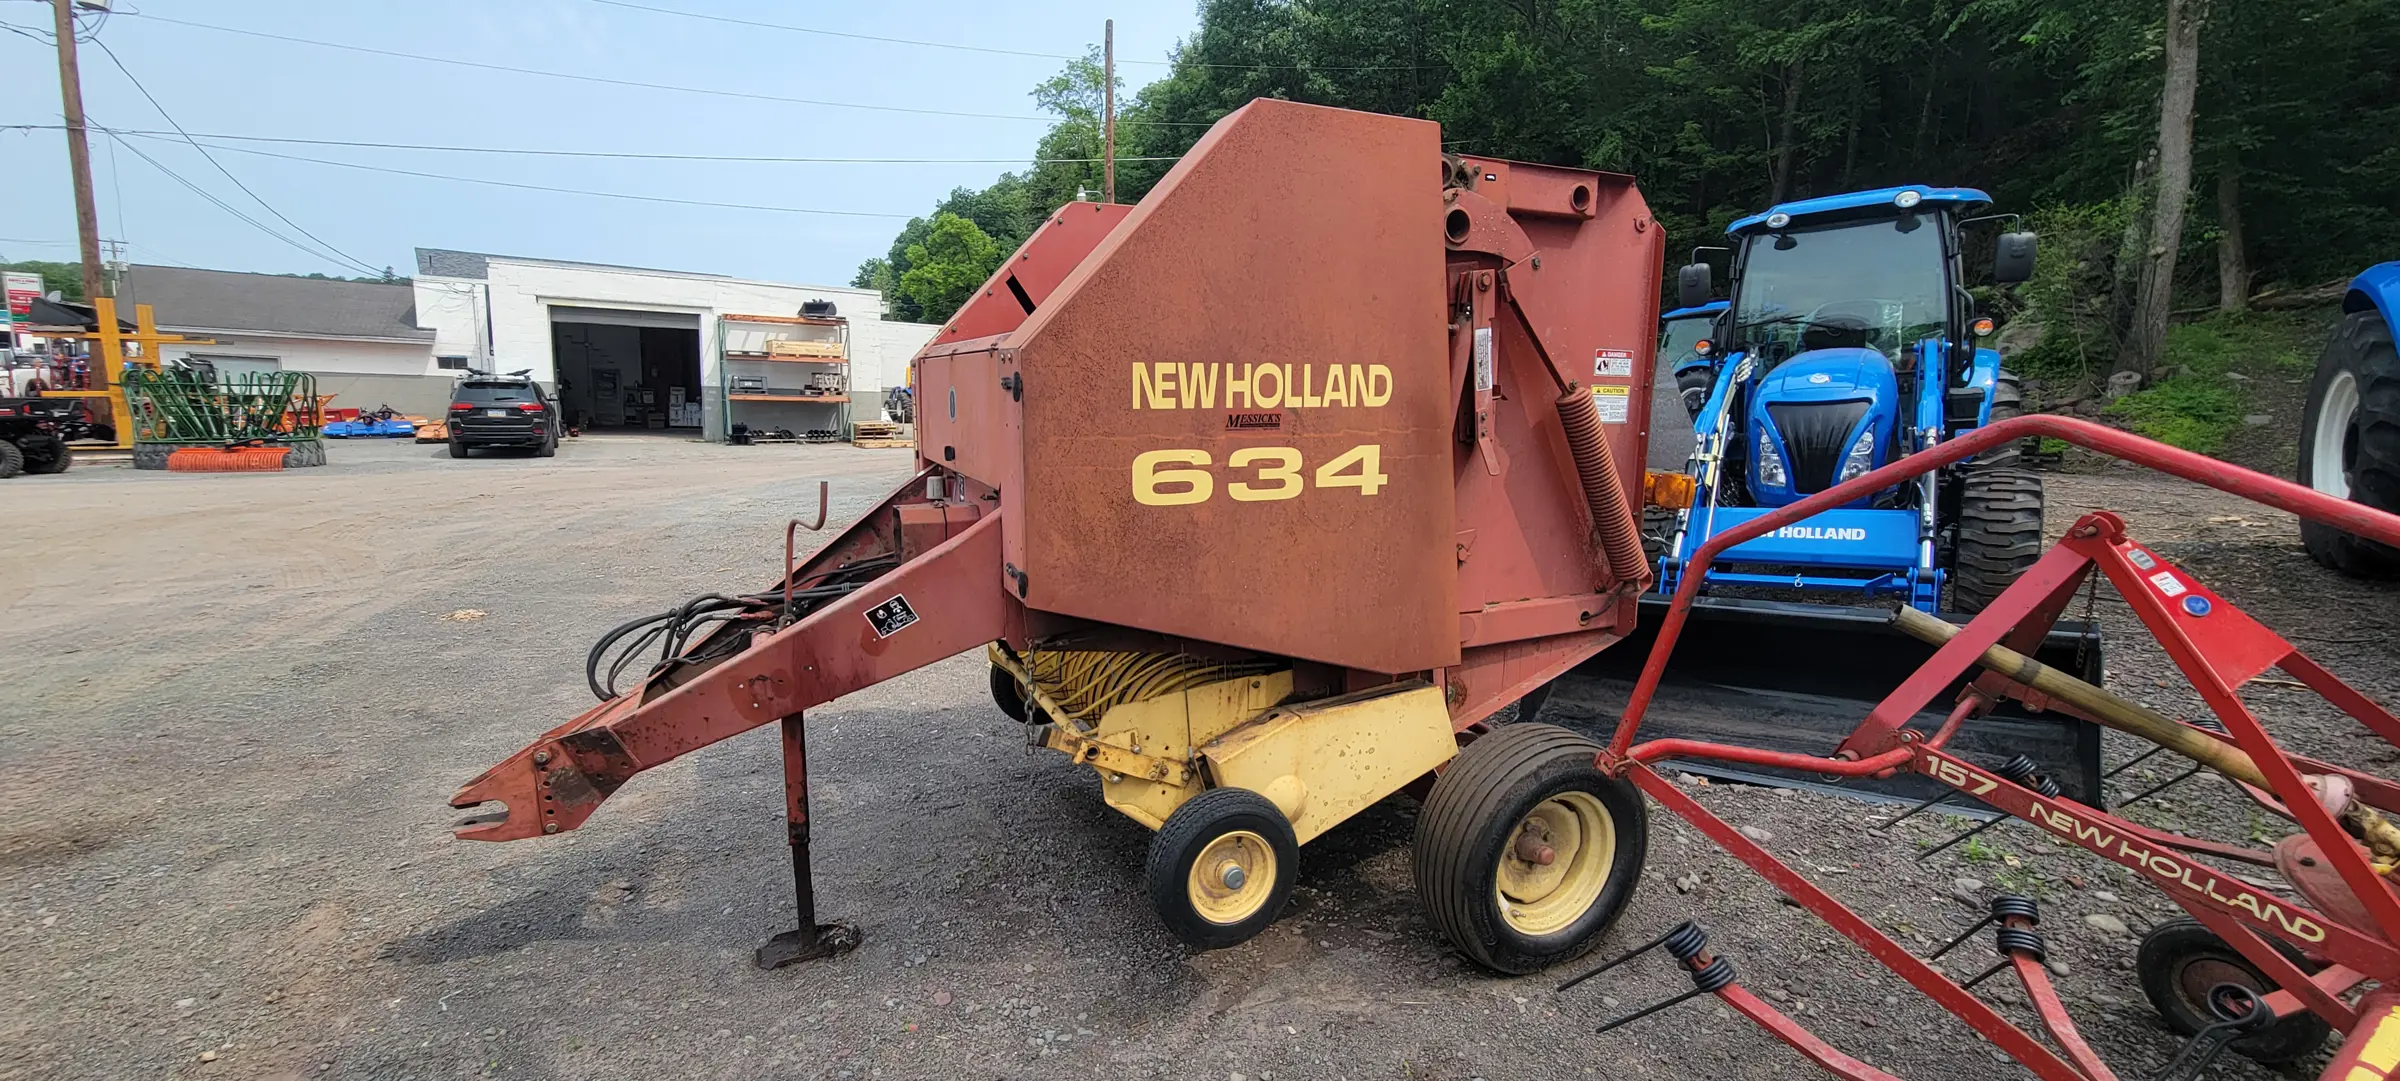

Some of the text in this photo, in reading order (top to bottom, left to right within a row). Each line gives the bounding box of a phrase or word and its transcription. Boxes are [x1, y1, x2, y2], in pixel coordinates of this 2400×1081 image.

[1132, 362, 1393, 410] NEW HOLLAND
[1225, 413, 1282, 428] MESSICK'S
[1131, 444, 1389, 506] 634
[1779, 526, 1866, 541] HOLLAND
[1926, 755, 1999, 796] 157
[2030, 801, 2326, 943] NEW HOLLAND
